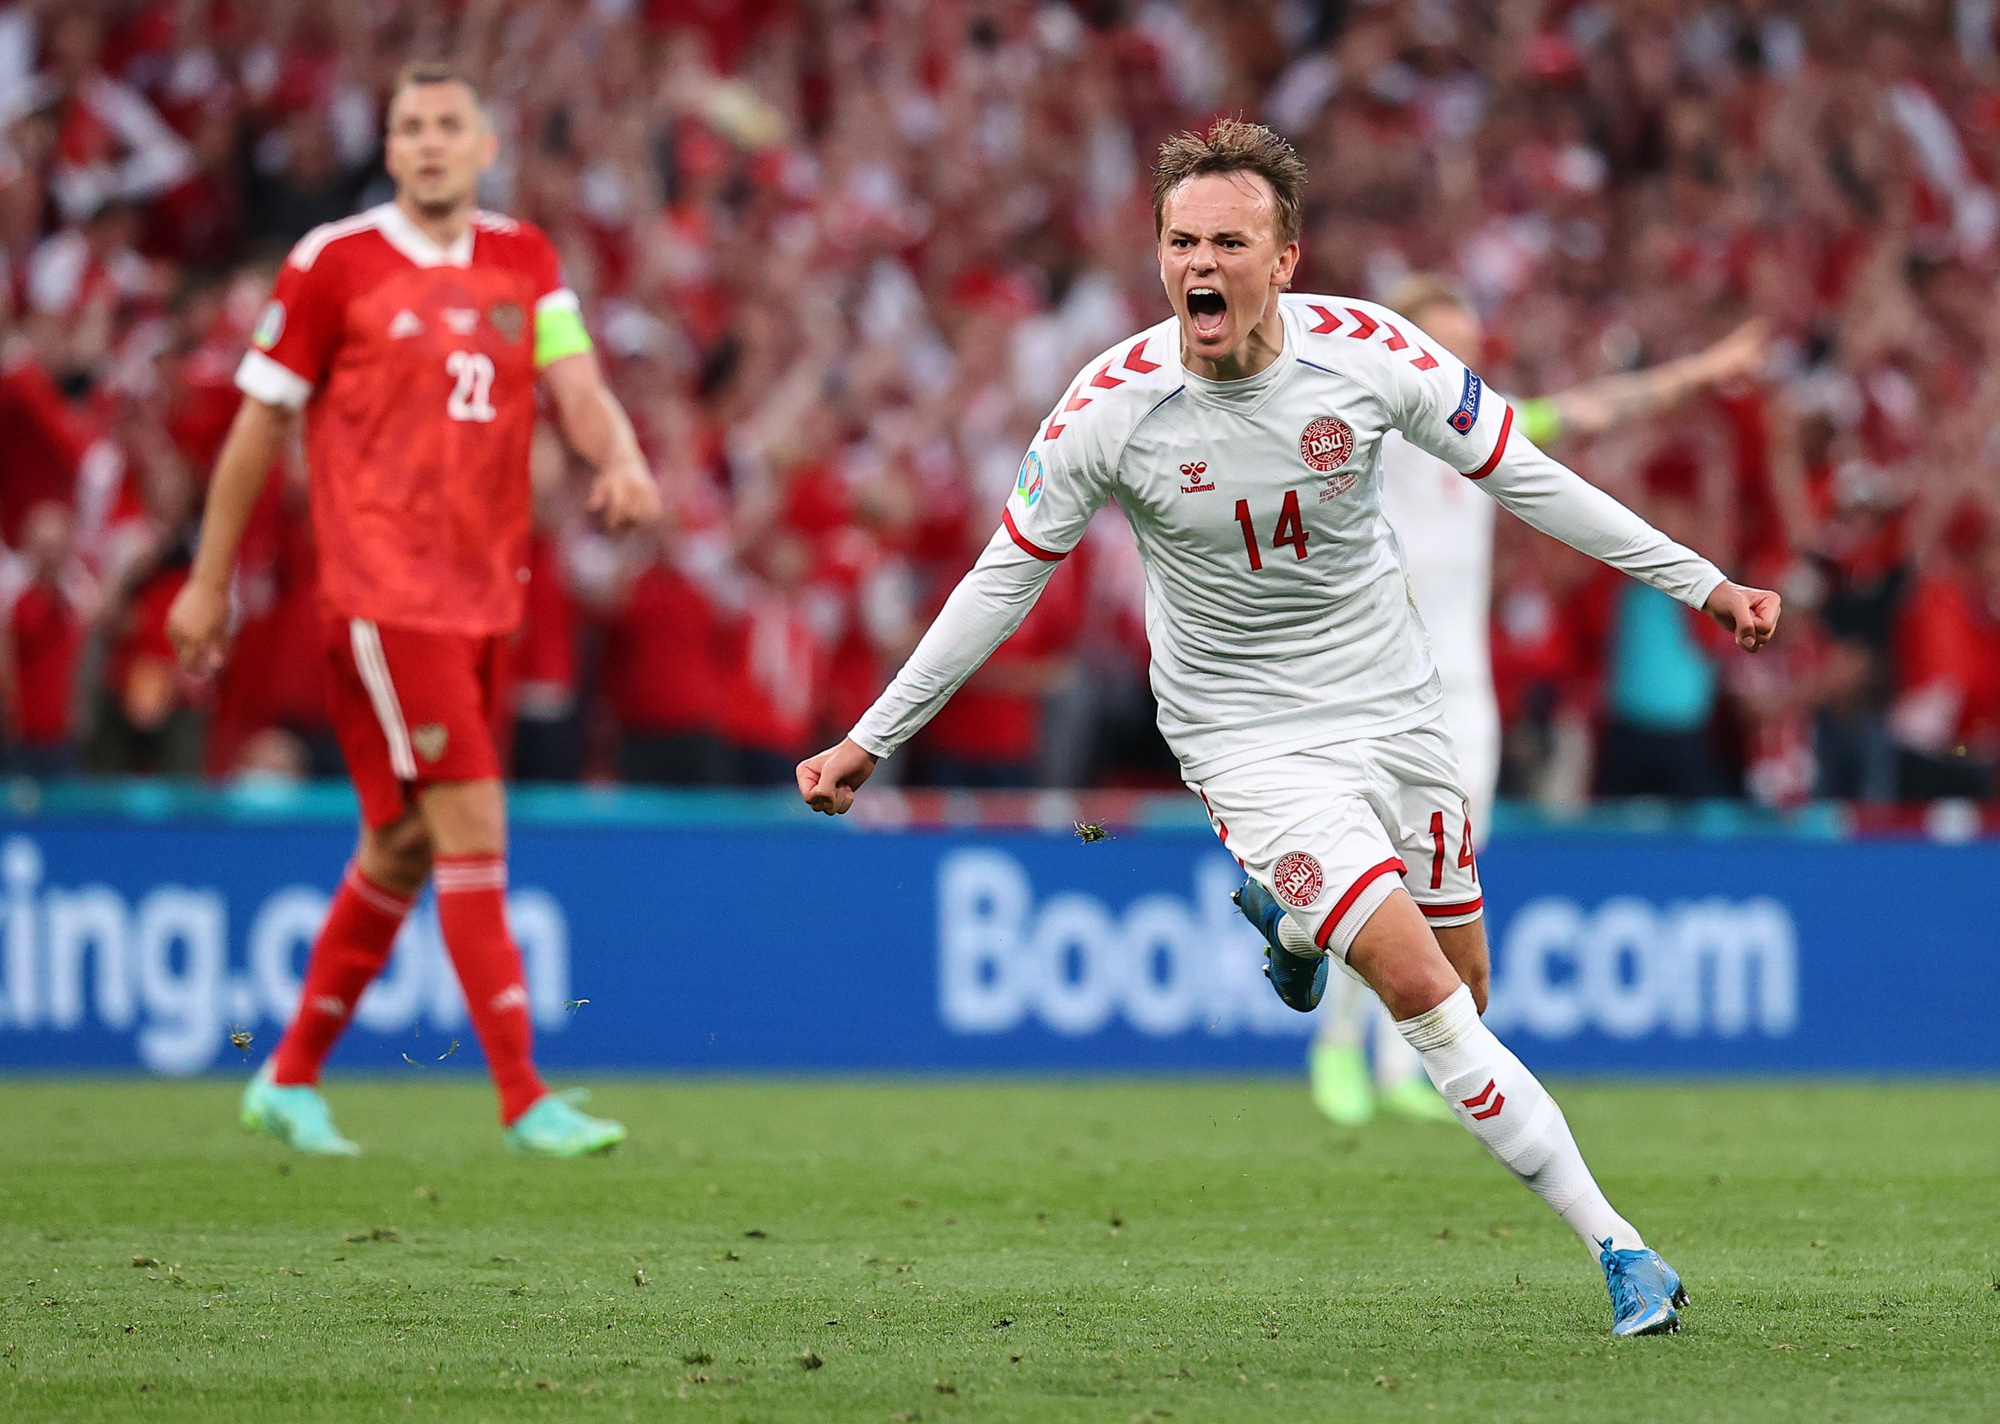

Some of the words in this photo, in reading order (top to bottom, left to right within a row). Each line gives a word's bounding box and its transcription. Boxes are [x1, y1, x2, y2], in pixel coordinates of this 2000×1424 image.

[445, 351, 497, 423] 22
[1465, 370, 1478, 414] RESPECT
[1310, 433, 1344, 456] DBU
[1180, 481, 1216, 494] hummel
[1235, 490, 1310, 571] 14
[1429, 811, 1477, 889] 14
[1284, 863, 1313, 896] DBU
[938, 848, 1799, 1038] Book.com
